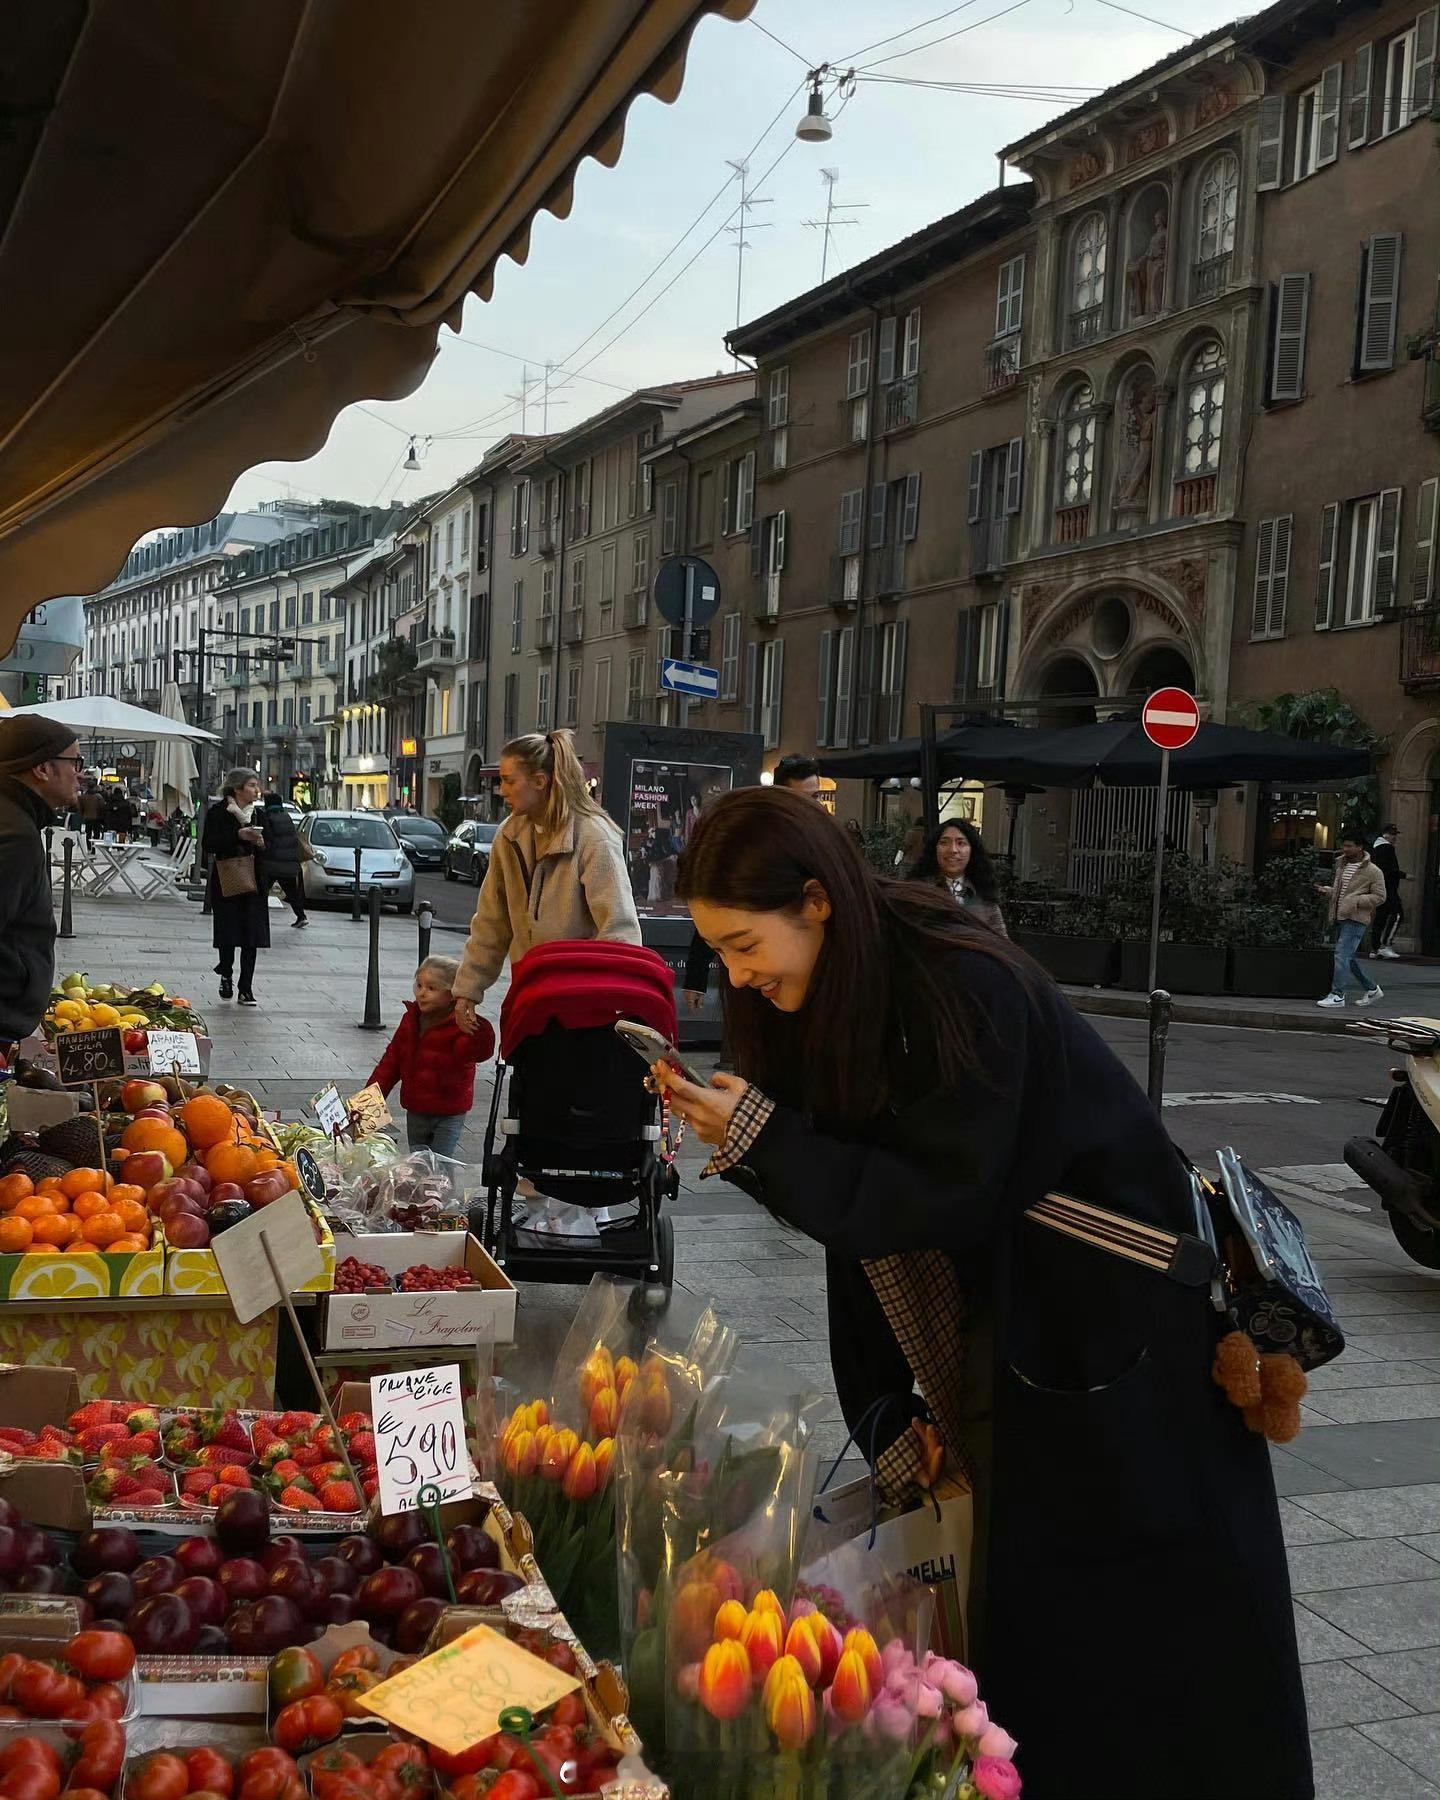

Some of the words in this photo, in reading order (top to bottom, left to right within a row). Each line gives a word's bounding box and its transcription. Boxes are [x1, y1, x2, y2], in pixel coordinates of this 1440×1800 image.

[635, 785, 664, 793] MILANO
[634, 794, 668, 802] FASHION
[634, 802, 657, 810] WEEK
[407, 1296, 438, 1317] Le
[385, 1421, 456, 1486] 5,90
